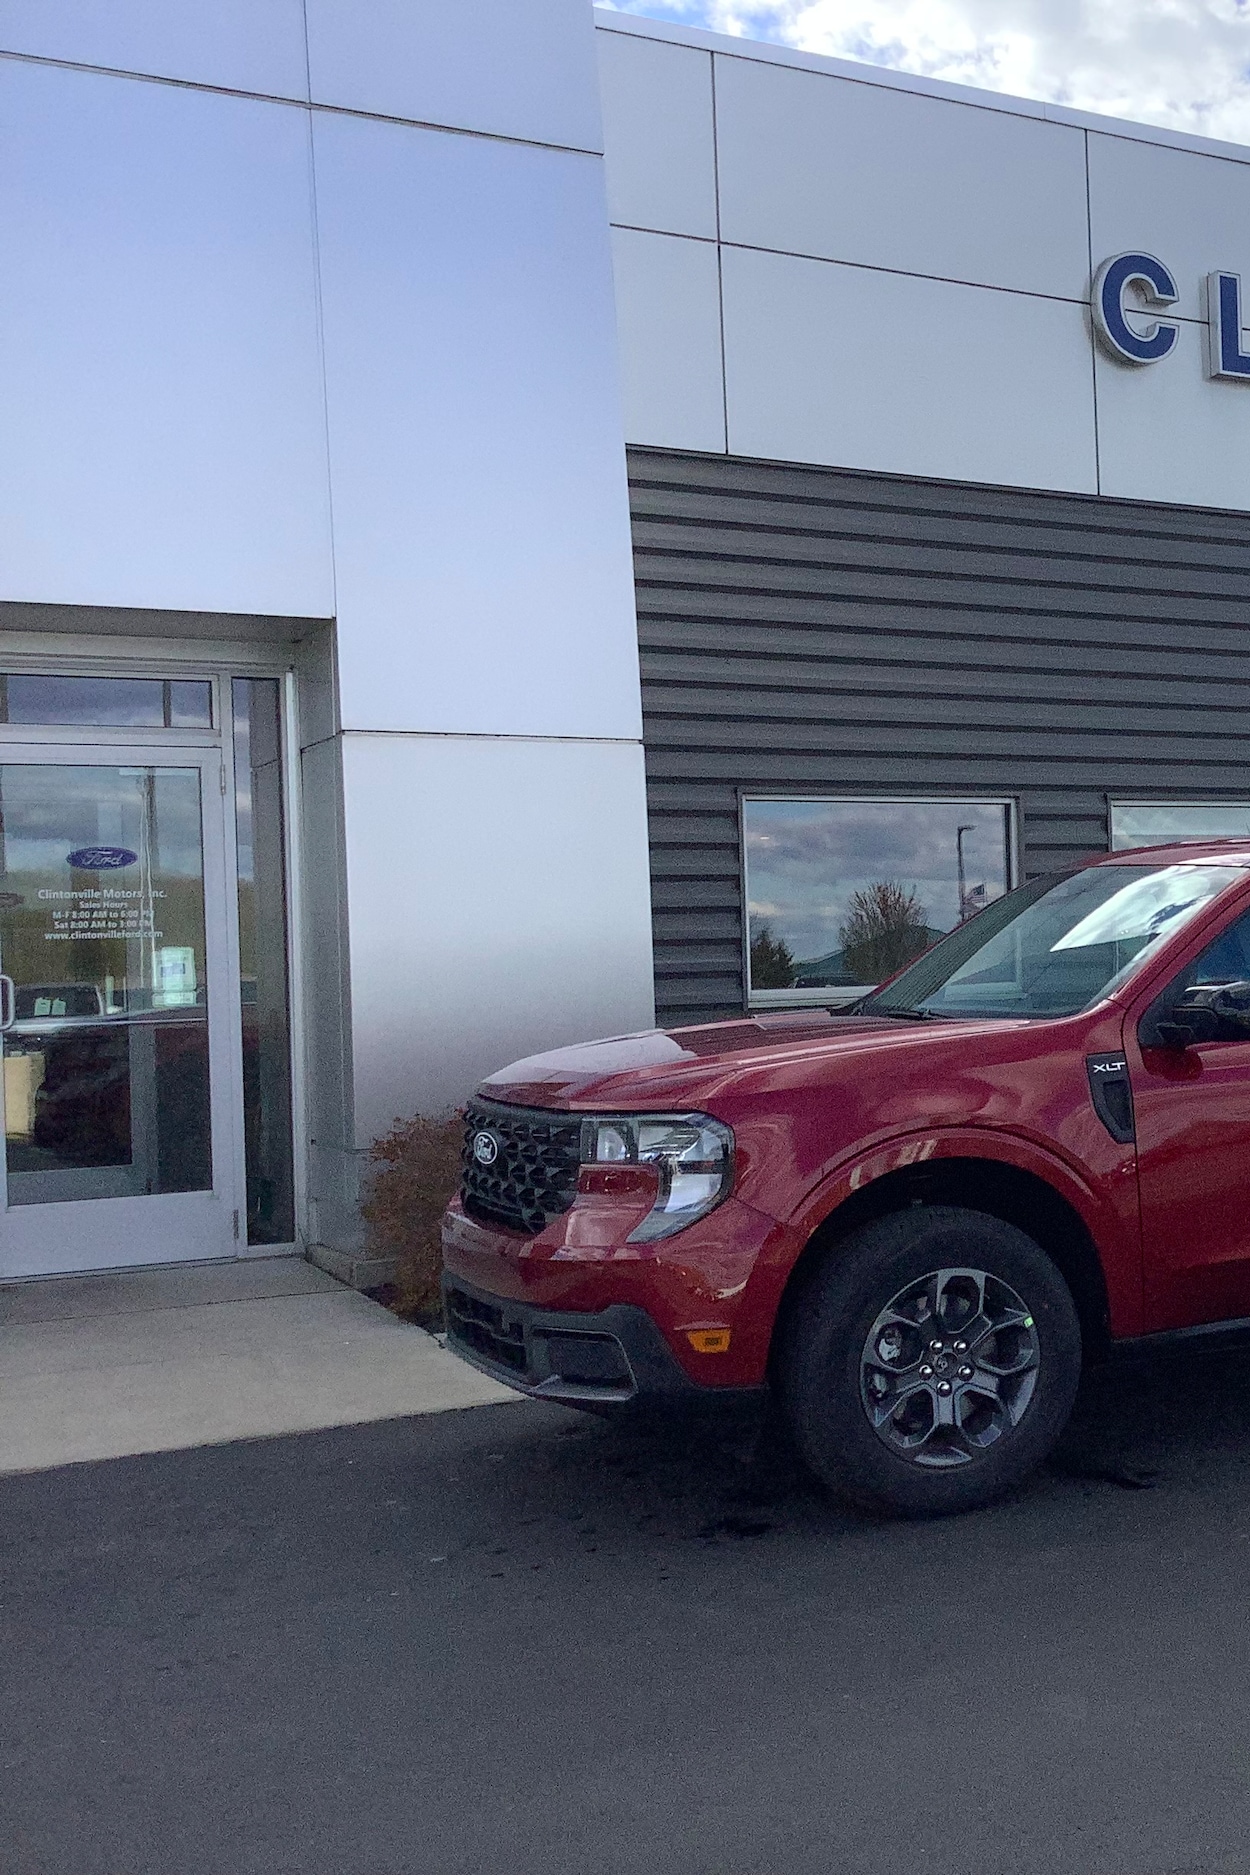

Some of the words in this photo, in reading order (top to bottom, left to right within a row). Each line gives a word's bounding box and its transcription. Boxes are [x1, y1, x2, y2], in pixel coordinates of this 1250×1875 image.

[81, 849, 124, 866] Ford
[37, 889, 101, 899] Clintonville
[103, 889, 145, 899] Motors,
[79, 901, 101, 909] Sales
[102, 901, 128, 909] Hours
[52, 911, 70, 919] M-F
[92, 911, 108, 919] AM
[54, 921, 69, 929] Sat
[90, 920, 106, 928] AM
[107, 920, 118, 928] to
[44, 930, 163, 940] www.clintonvilleford.com
[1093, 1061, 1126, 1073] XLT
[476, 1135, 493, 1160] Ford
